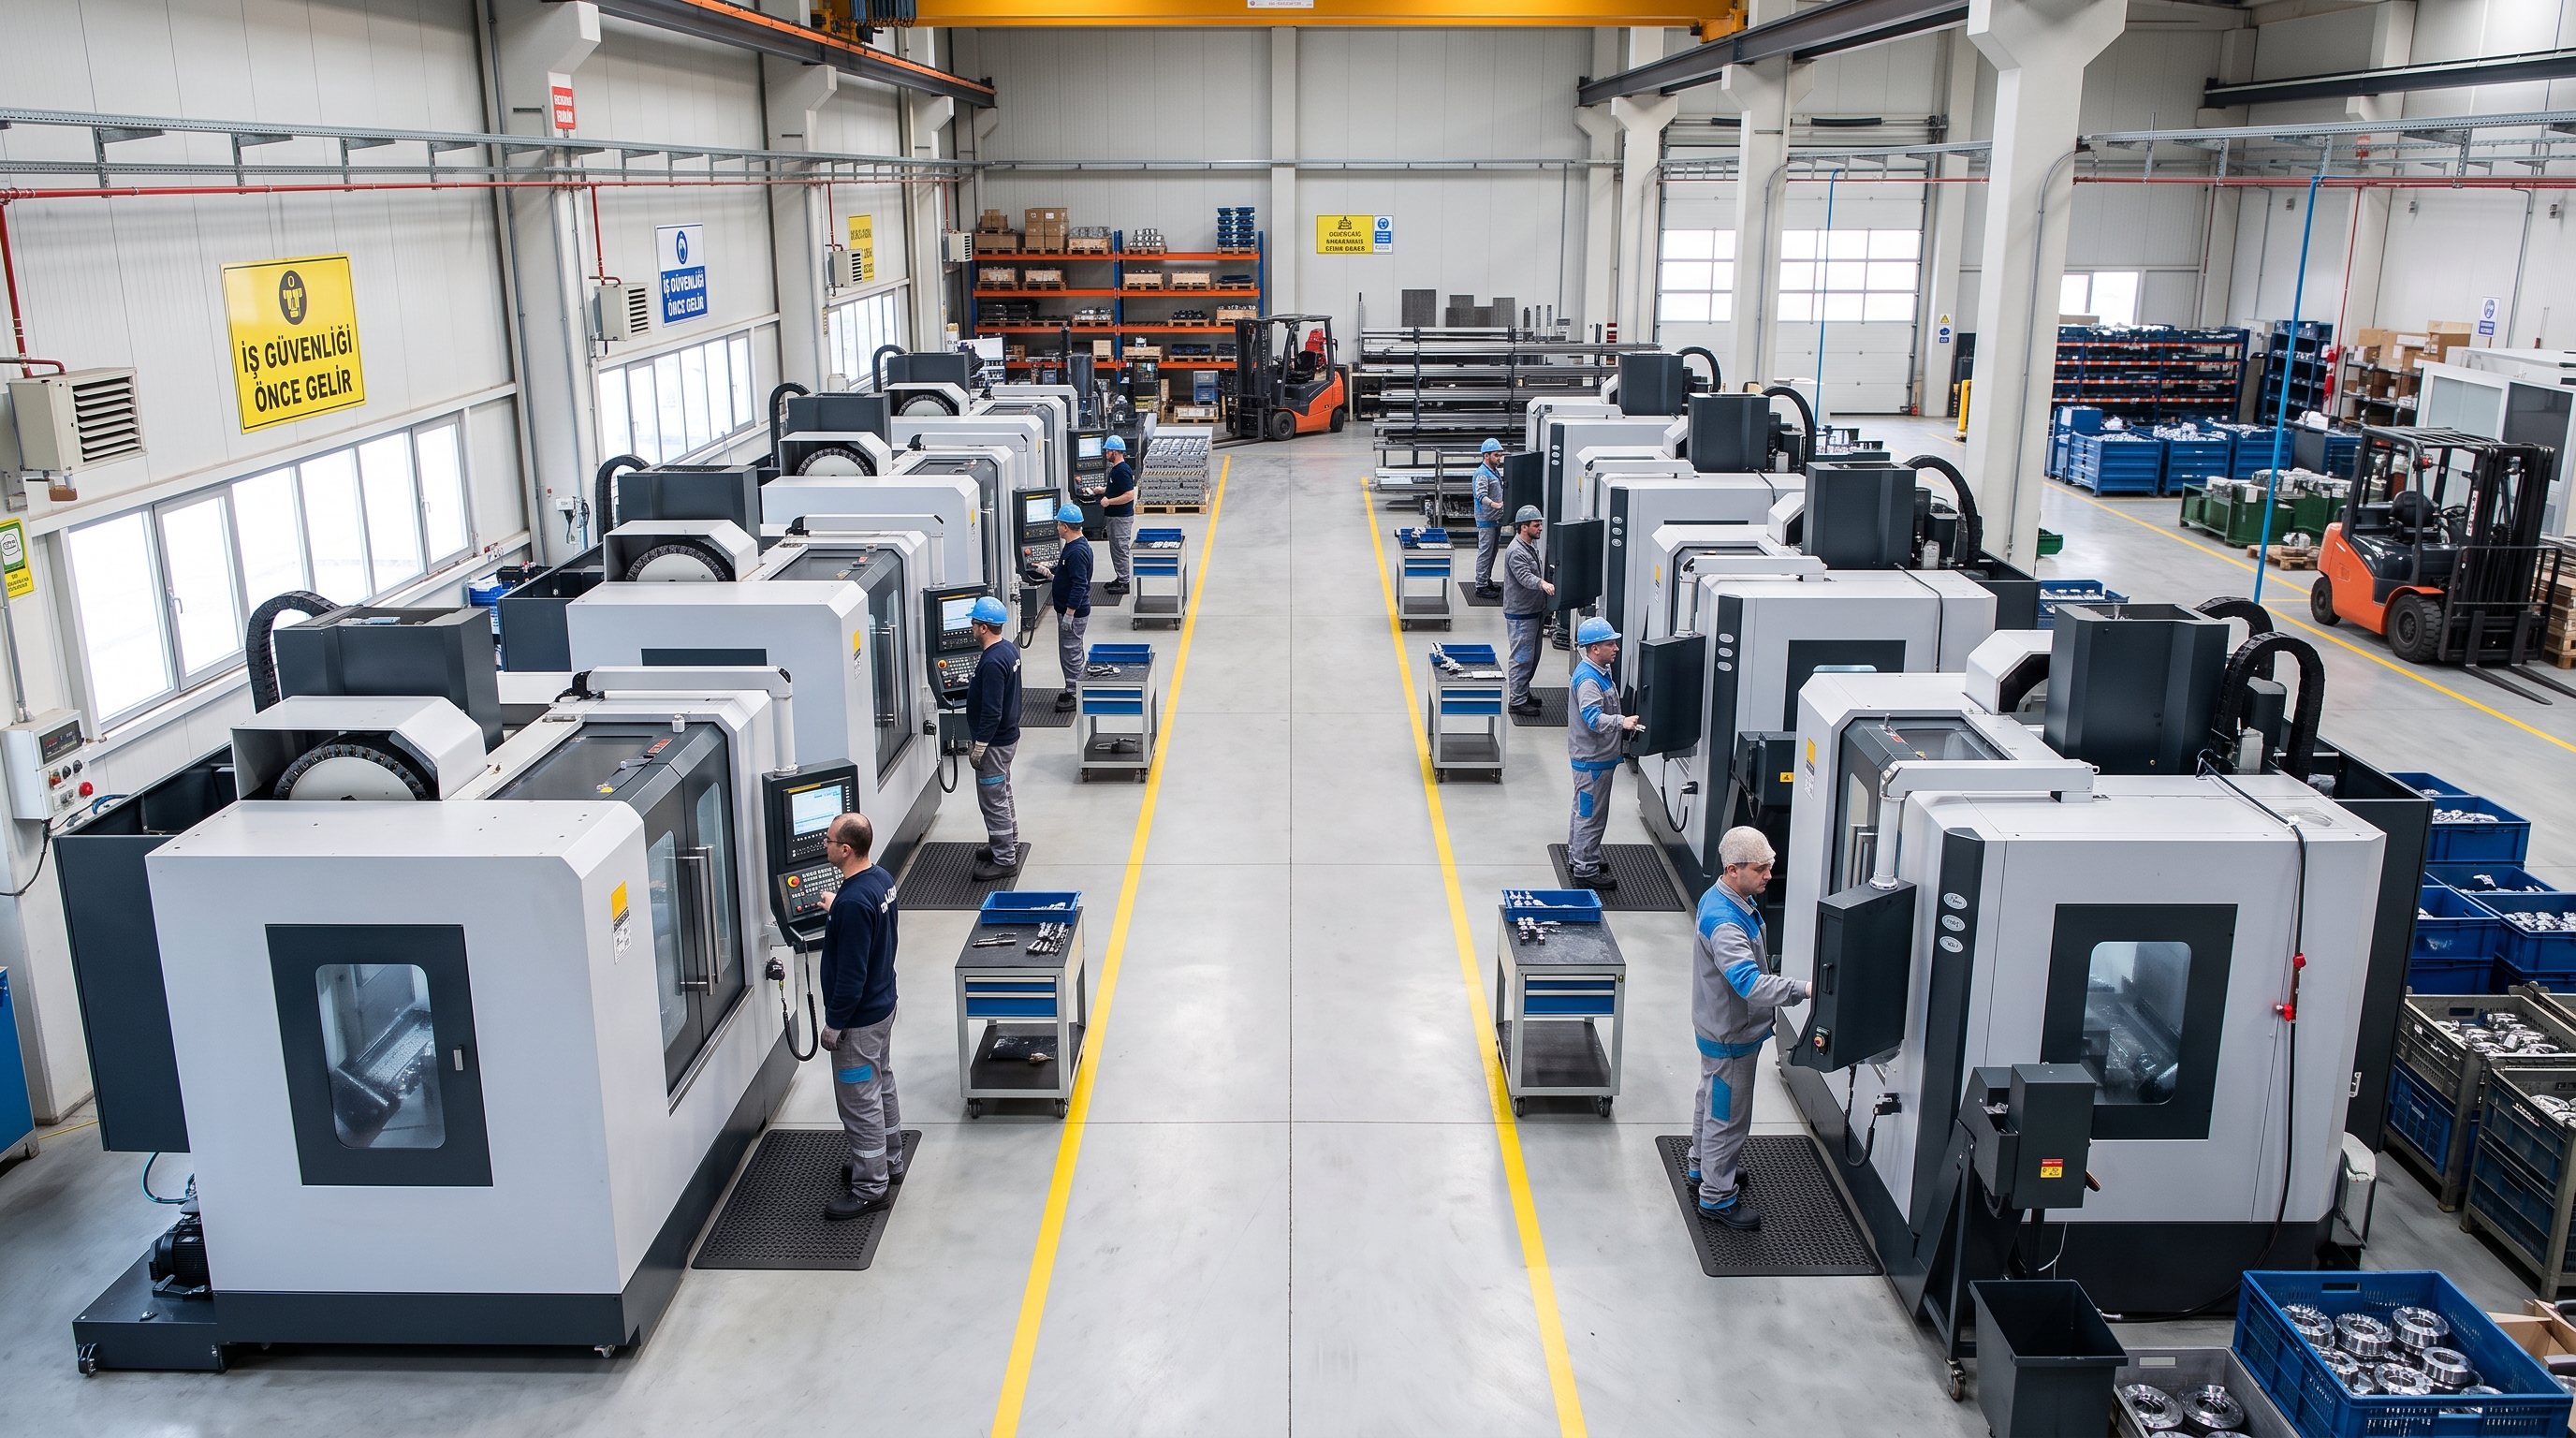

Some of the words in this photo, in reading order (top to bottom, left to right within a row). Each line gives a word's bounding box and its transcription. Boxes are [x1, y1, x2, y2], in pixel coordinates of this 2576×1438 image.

[242, 340, 260, 379] İŞ
[265, 324, 353, 369] GÜVENLİĞİ
[255, 380, 302, 413] ÖNCE
[306, 364, 353, 402] GELİR
